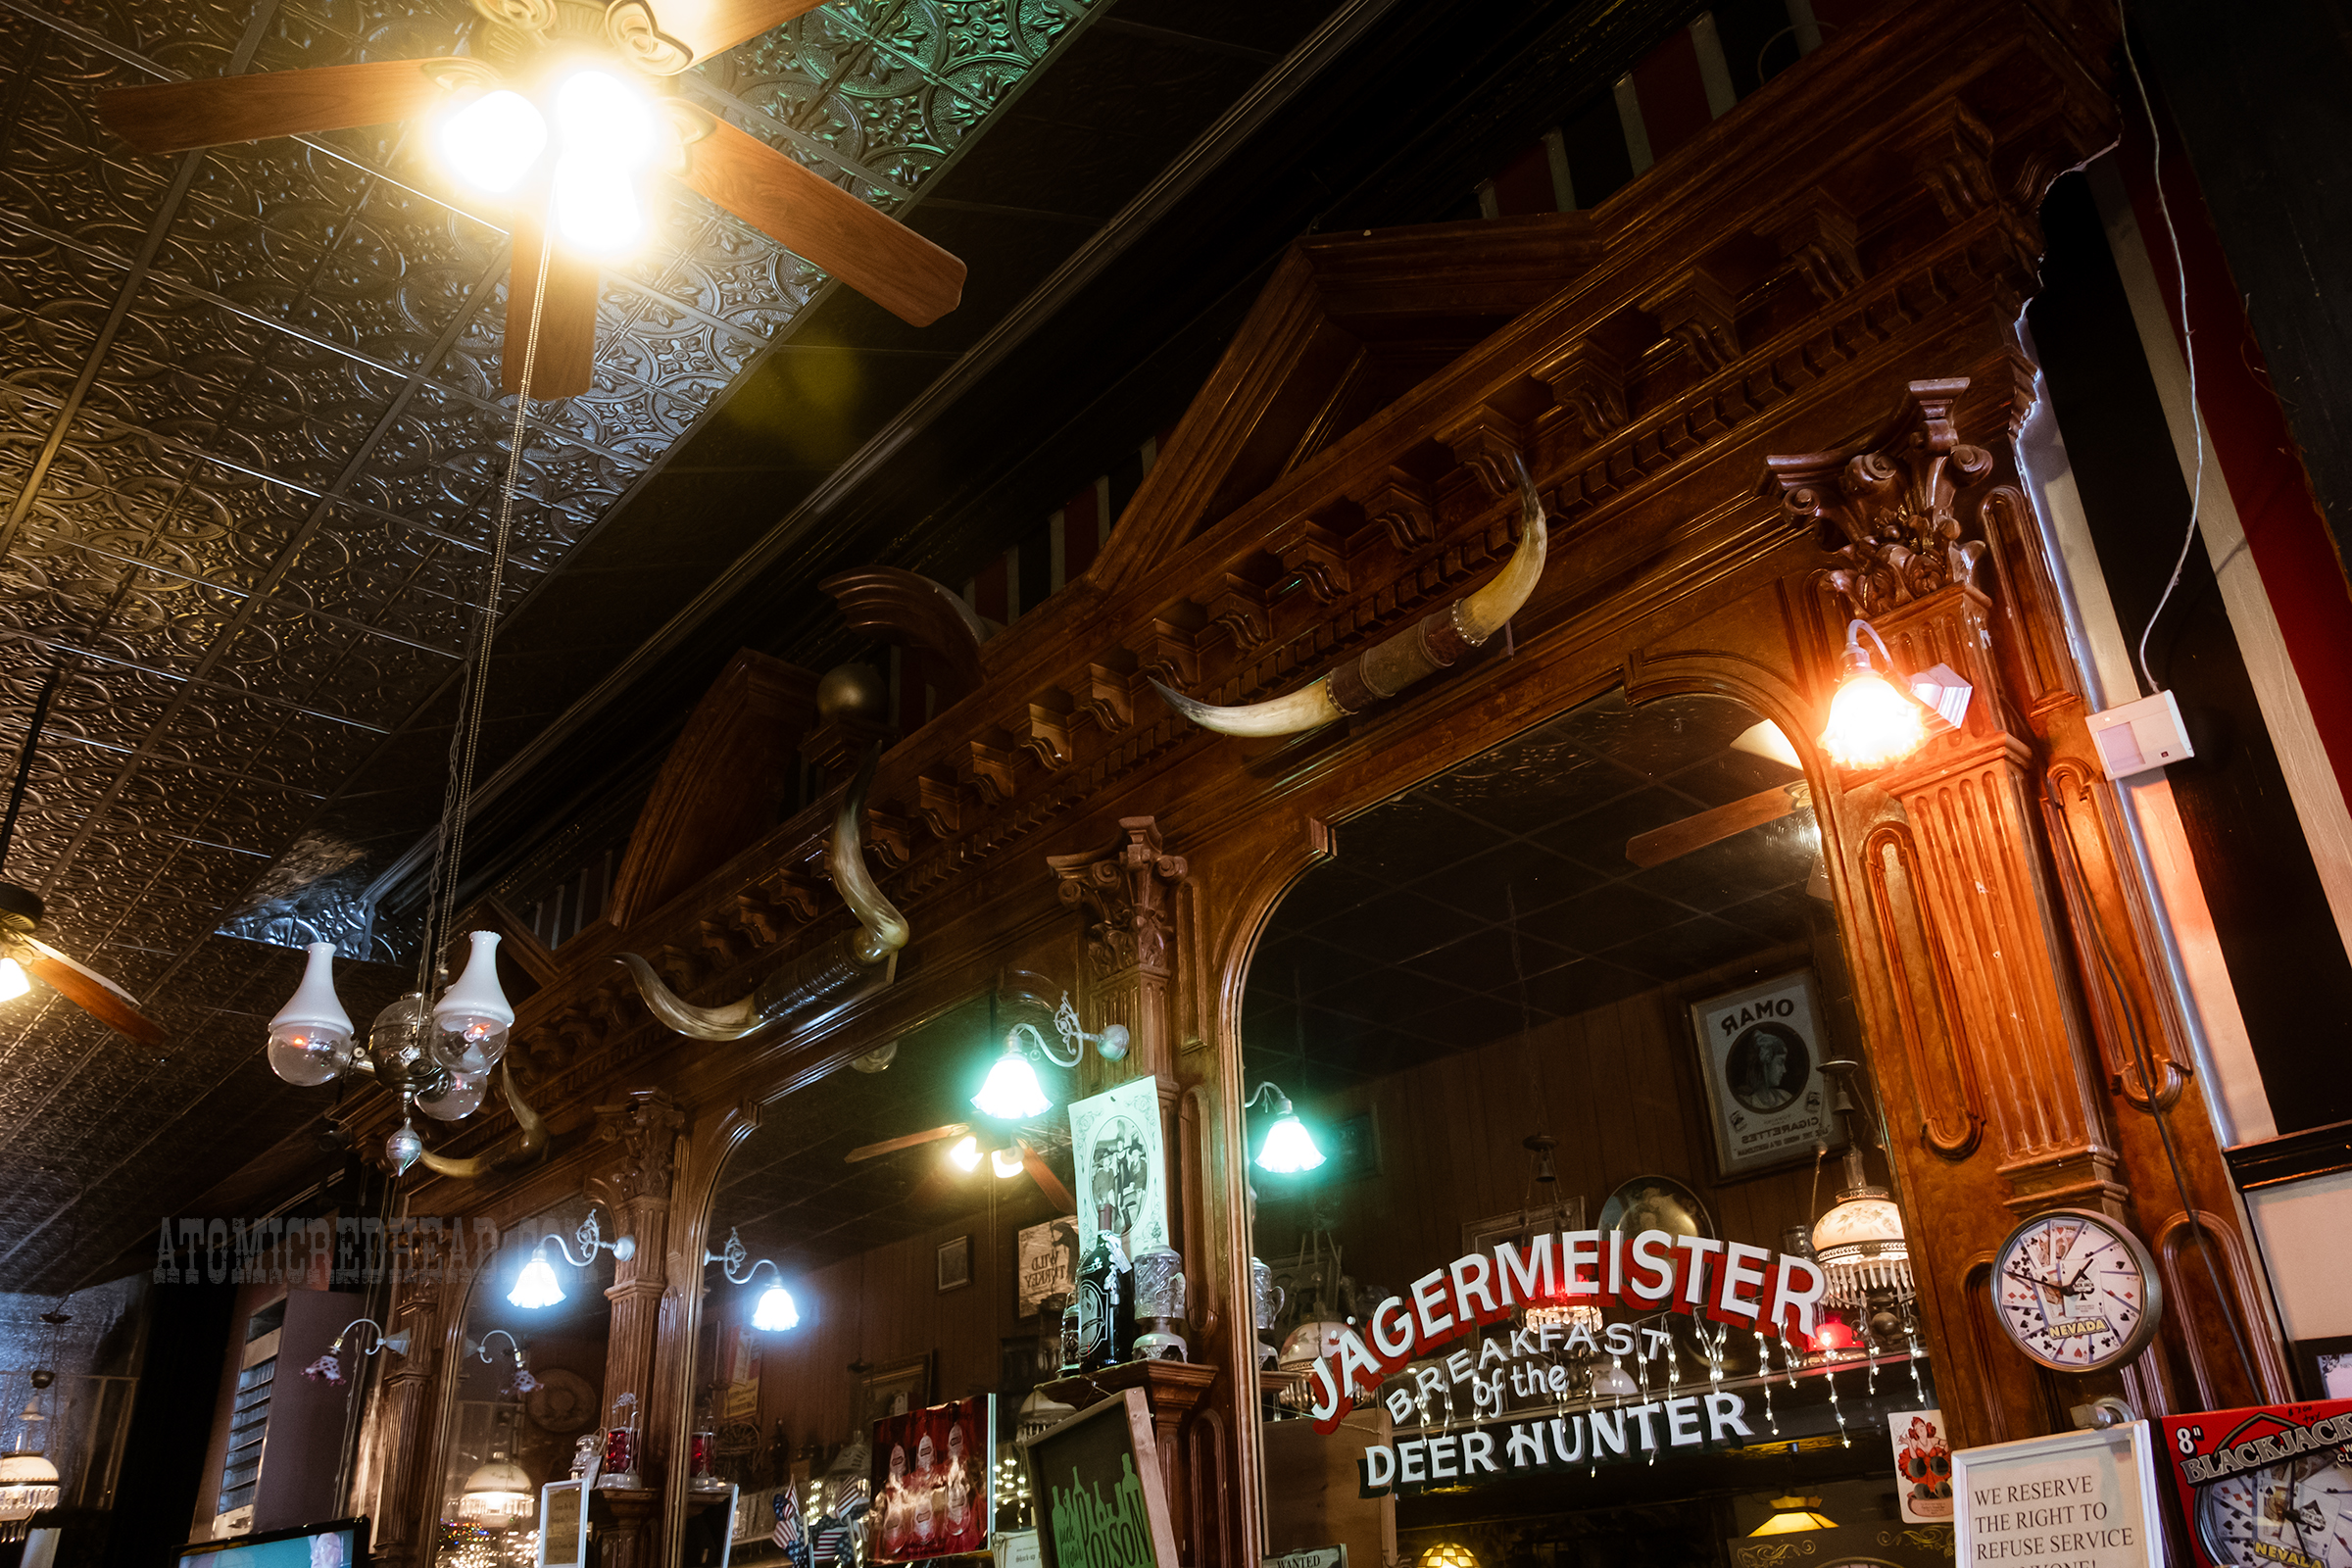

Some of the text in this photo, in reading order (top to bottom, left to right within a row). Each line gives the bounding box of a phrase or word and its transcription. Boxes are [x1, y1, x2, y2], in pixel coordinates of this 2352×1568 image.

[1311, 1229, 1827, 1433] JÄGERMEISTER
[2048, 1318, 2108, 1339] NEVADA
[1385, 1322, 1673, 1425] BREAKFAST
[1472, 1360, 1569, 1419] of the
[1361, 1393, 1752, 1491] DEER HUNTER
[2177, 1426, 2203, 1454] 8"
[2180, 1412, 2352, 1485] BLACKJACK
[1974, 1475, 2093, 1506] WE RESERVE
[1074, 1489, 1152, 1568] POISON
[1975, 1501, 2108, 1534] THE RIGHT TO
[1277, 1555, 1321, 1568] WANTED
[1977, 1527, 2134, 1560] REFUSE SERVICE
